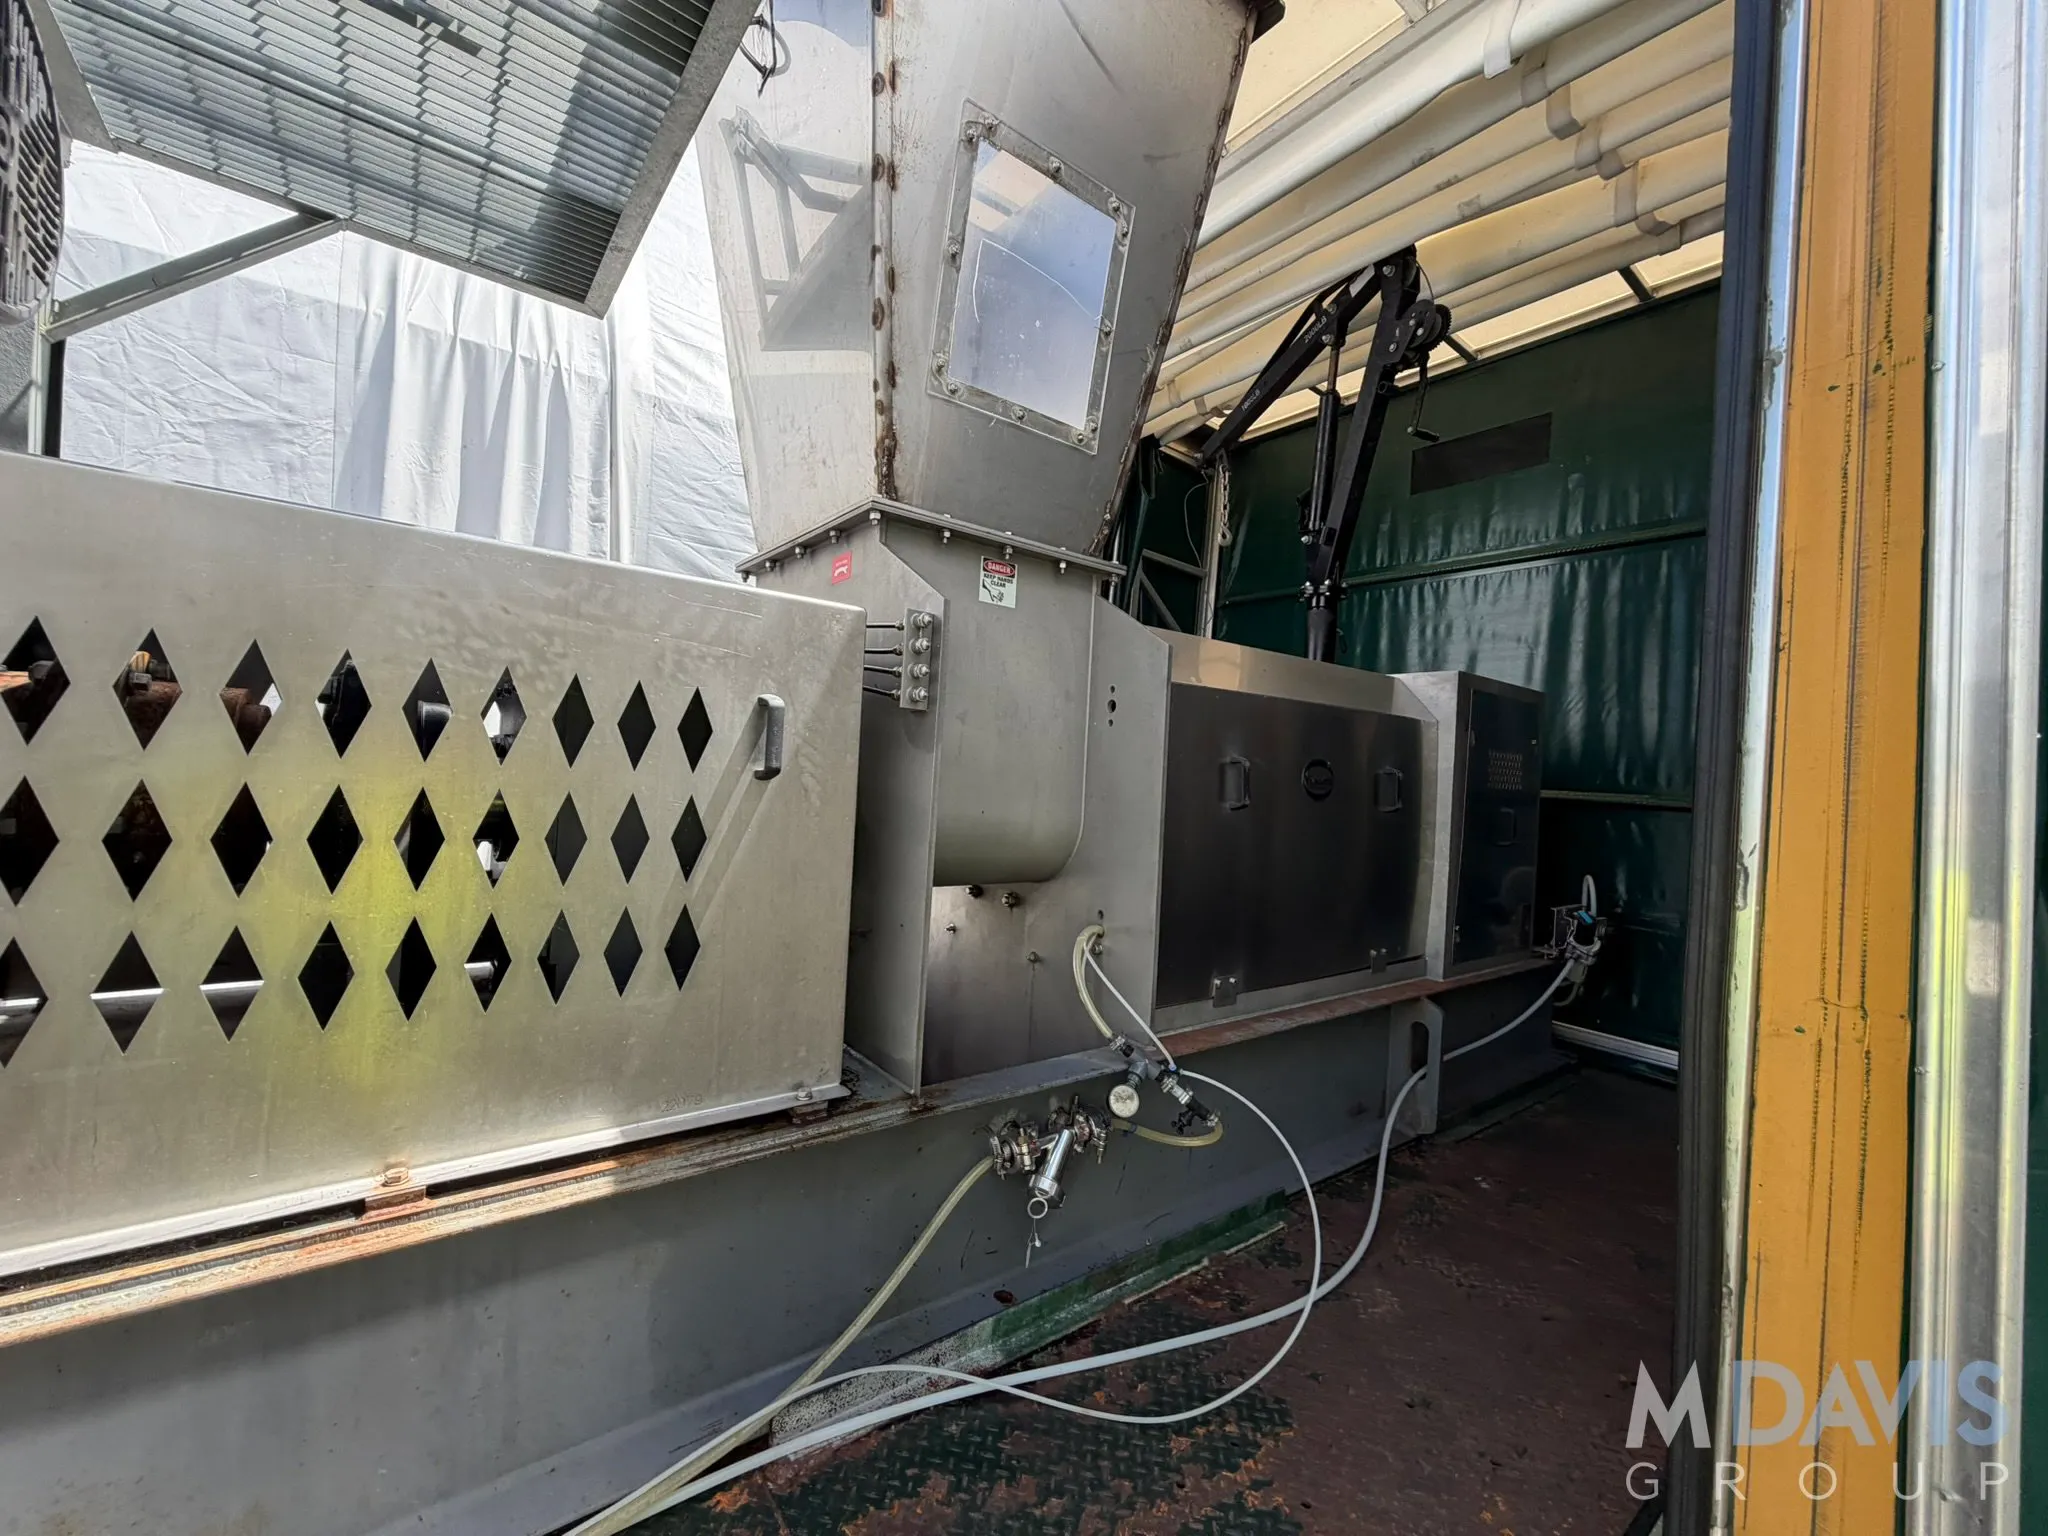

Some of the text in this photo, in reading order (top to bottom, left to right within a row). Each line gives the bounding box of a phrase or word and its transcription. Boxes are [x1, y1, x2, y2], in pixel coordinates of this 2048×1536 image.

[988, 562, 1011, 574] DANGER
[991, 580, 1006, 588] CLEAR
[997, 576, 1014, 584] HANDS
